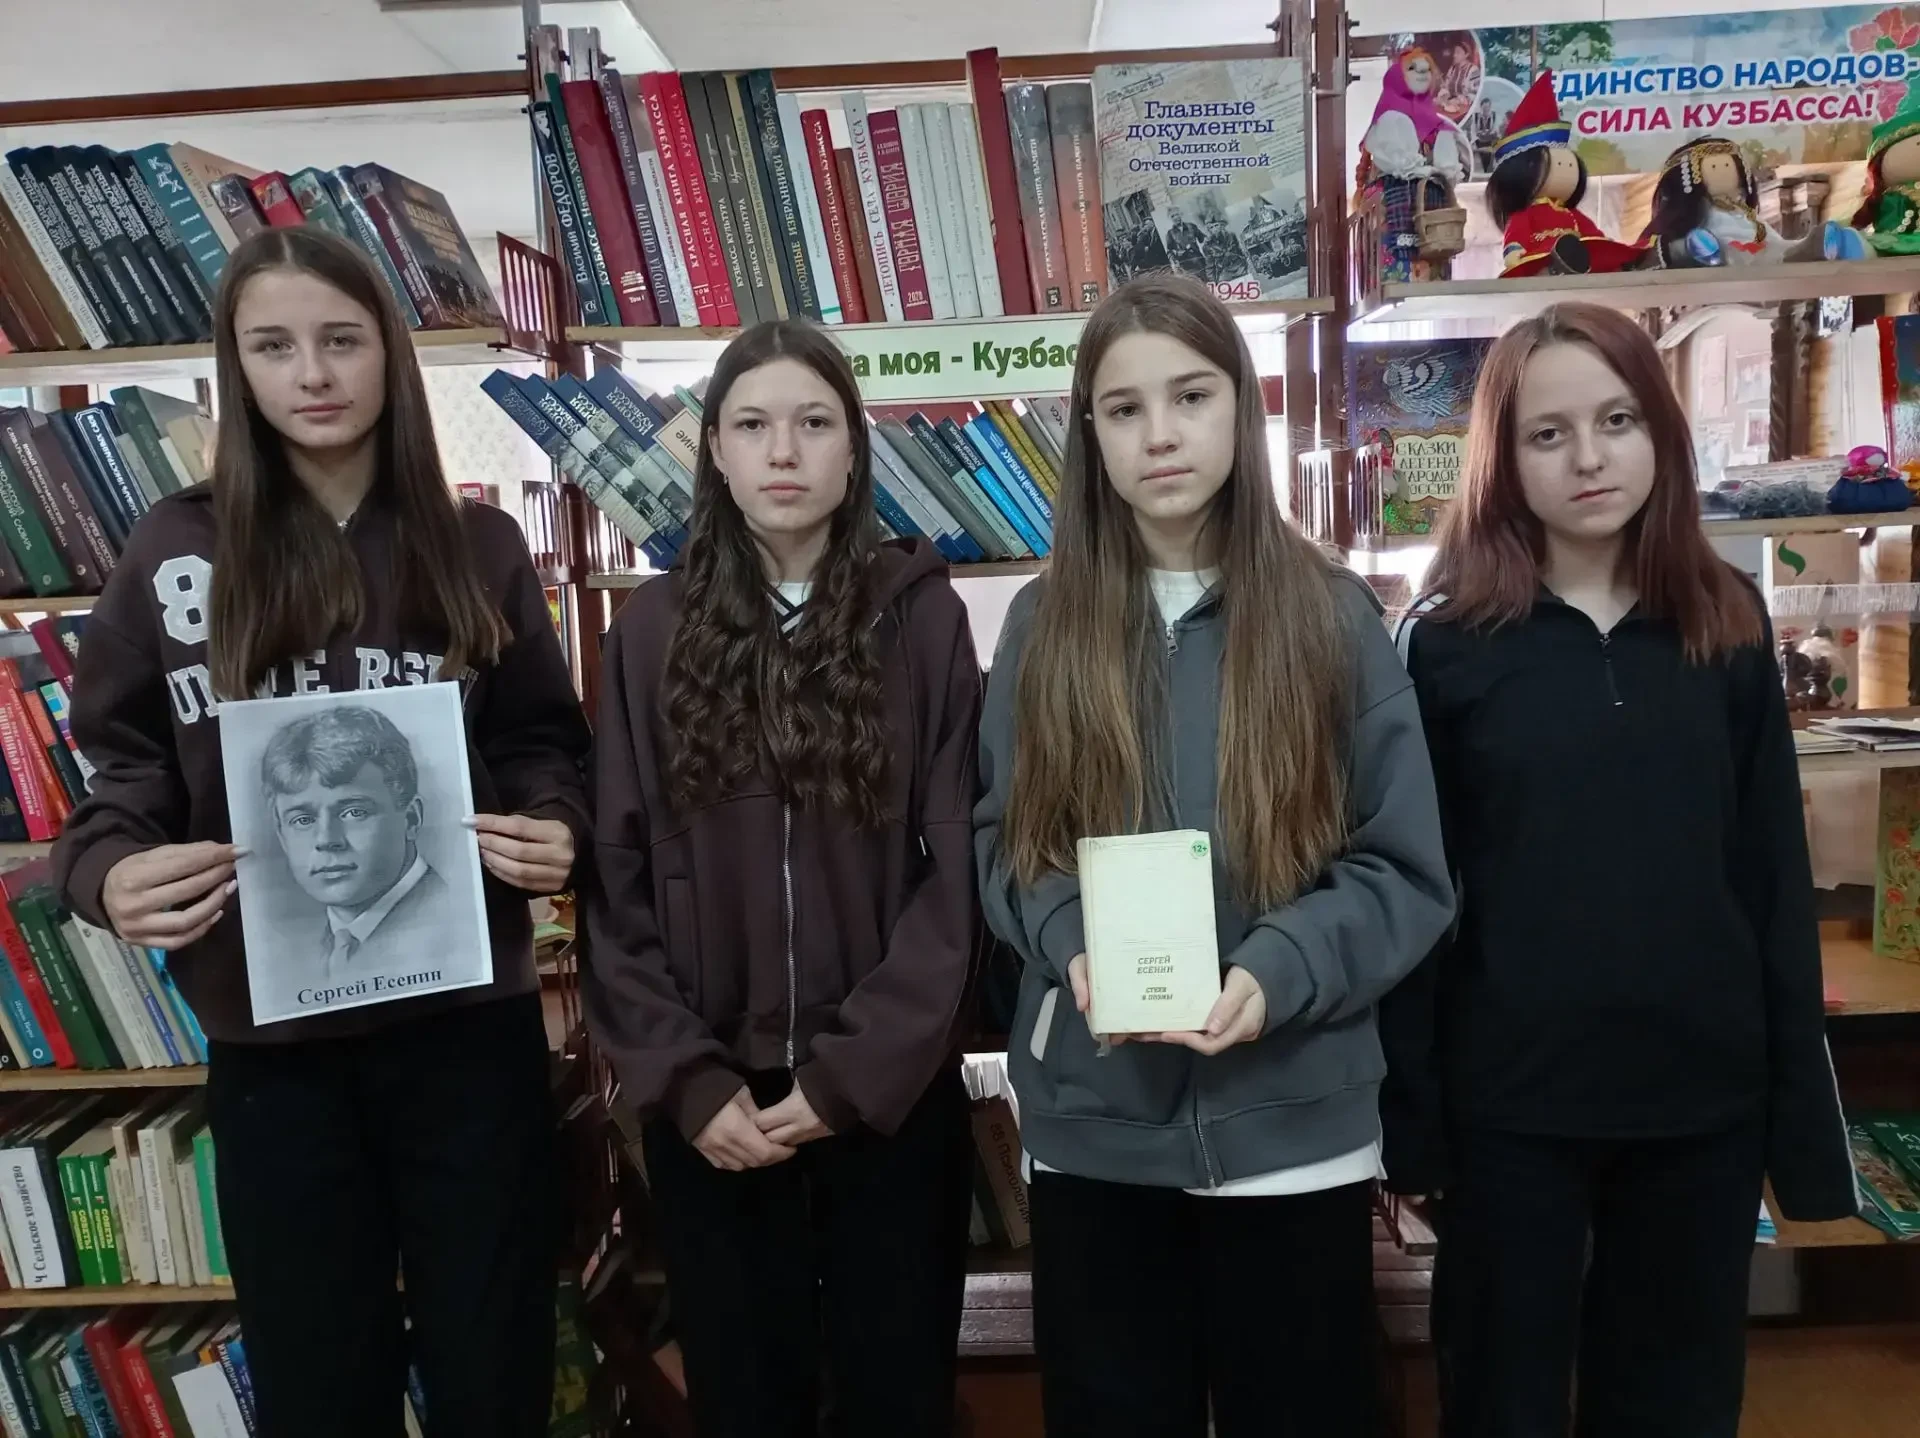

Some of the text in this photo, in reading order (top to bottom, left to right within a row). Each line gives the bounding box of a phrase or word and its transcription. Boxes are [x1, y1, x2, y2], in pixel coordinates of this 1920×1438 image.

[758, 87, 779, 149] КУЗБАССА
[1126, 119, 1274, 142] документы
[1144, 101, 1256, 119] Главные
[1577, 94, 1874, 135] СИЛА КУЗБАССА!
[813, 120, 829, 170] КУЗБАССА
[851, 119, 873, 183] КУЗБАССА
[1030, 138, 1040, 174] ПАМЯТИ
[1130, 153, 1270, 172] Отечественной
[1159, 140, 1240, 155] Великой
[545, 151, 575, 228] ФЕДОРОВ
[649, 94, 698, 267] КРАСНАЯ КНИГА КУЗБАССА
[772, 153, 797, 236] ИЗБРАННИКИ
[823, 173, 835, 205] СЛАВА
[1035, 176, 1044, 203] КНИГА
[1169, 173, 1231, 186] войны
[19, 172, 64, 250] МИР ЖИВОТНЫХ
[48, 171, 95, 251] МИР ЖИВОТНЫХ
[64, 163, 110, 240] МИР ЖИВОТНЫХ
[91, 163, 138, 241] МИР ЖИВОТНЫХ
[125, 175, 160, 228] ЖИВОТНЫХ
[716, 197, 735, 244] КУЛЬТУРА
[737, 198, 754, 244] КУЛЬТУРА
[587, 228, 609, 286] КУЗБАСС
[635, 202, 668, 304] ГОРОДА СИБИРИ
[698, 210, 718, 266] КРАСНАЯ
[830, 215, 847, 265] ГОРДОСТЬ
[791, 240, 813, 307] НАРОДНЫЕ
[873, 230, 894, 296] ЛЕТОПИСЬ
[1050, 294, 1058, 305] 5
[1083, 292, 1098, 303] 20
[1208, 281, 1260, 301] 1945
[880, 351, 941, 376] моя
[973, 337, 1078, 378] Кузбас
[575, 392, 599, 414] АССА
[606, 391, 648, 436] ИСТОРИЯ
[612, 385, 653, 429] КУЗБАССА
[675, 428, 701, 457] ение
[1396, 441, 1456, 455] СКАЗКИ
[87, 414, 138, 516] СЛОВАРЬ ИНОСТРАННЫХ СЛОВ
[1000, 446, 1026, 482] КУЗБАСС
[1404, 470, 1460, 483] АРОДОВ
[1021, 478, 1052, 520] СЕВЕРНЫЙ
[1409, 484, 1454, 494] ОССИИ
[13, 518, 32, 550] СЛОВАРЬ
[1192, 844, 1207, 853] 12+
[1136, 965, 1174, 974] ЕСЕНИН
[1138, 955, 1171, 965] СЕРГЕЙ
[297, 970, 442, 1004] Сергей Есенин
[12, 1164, 45, 1271] Сельское хозяйство
[78, 1208, 92, 1250] СОВЕТЫ
[101, 1207, 113, 1249] СОВЕТЫ
